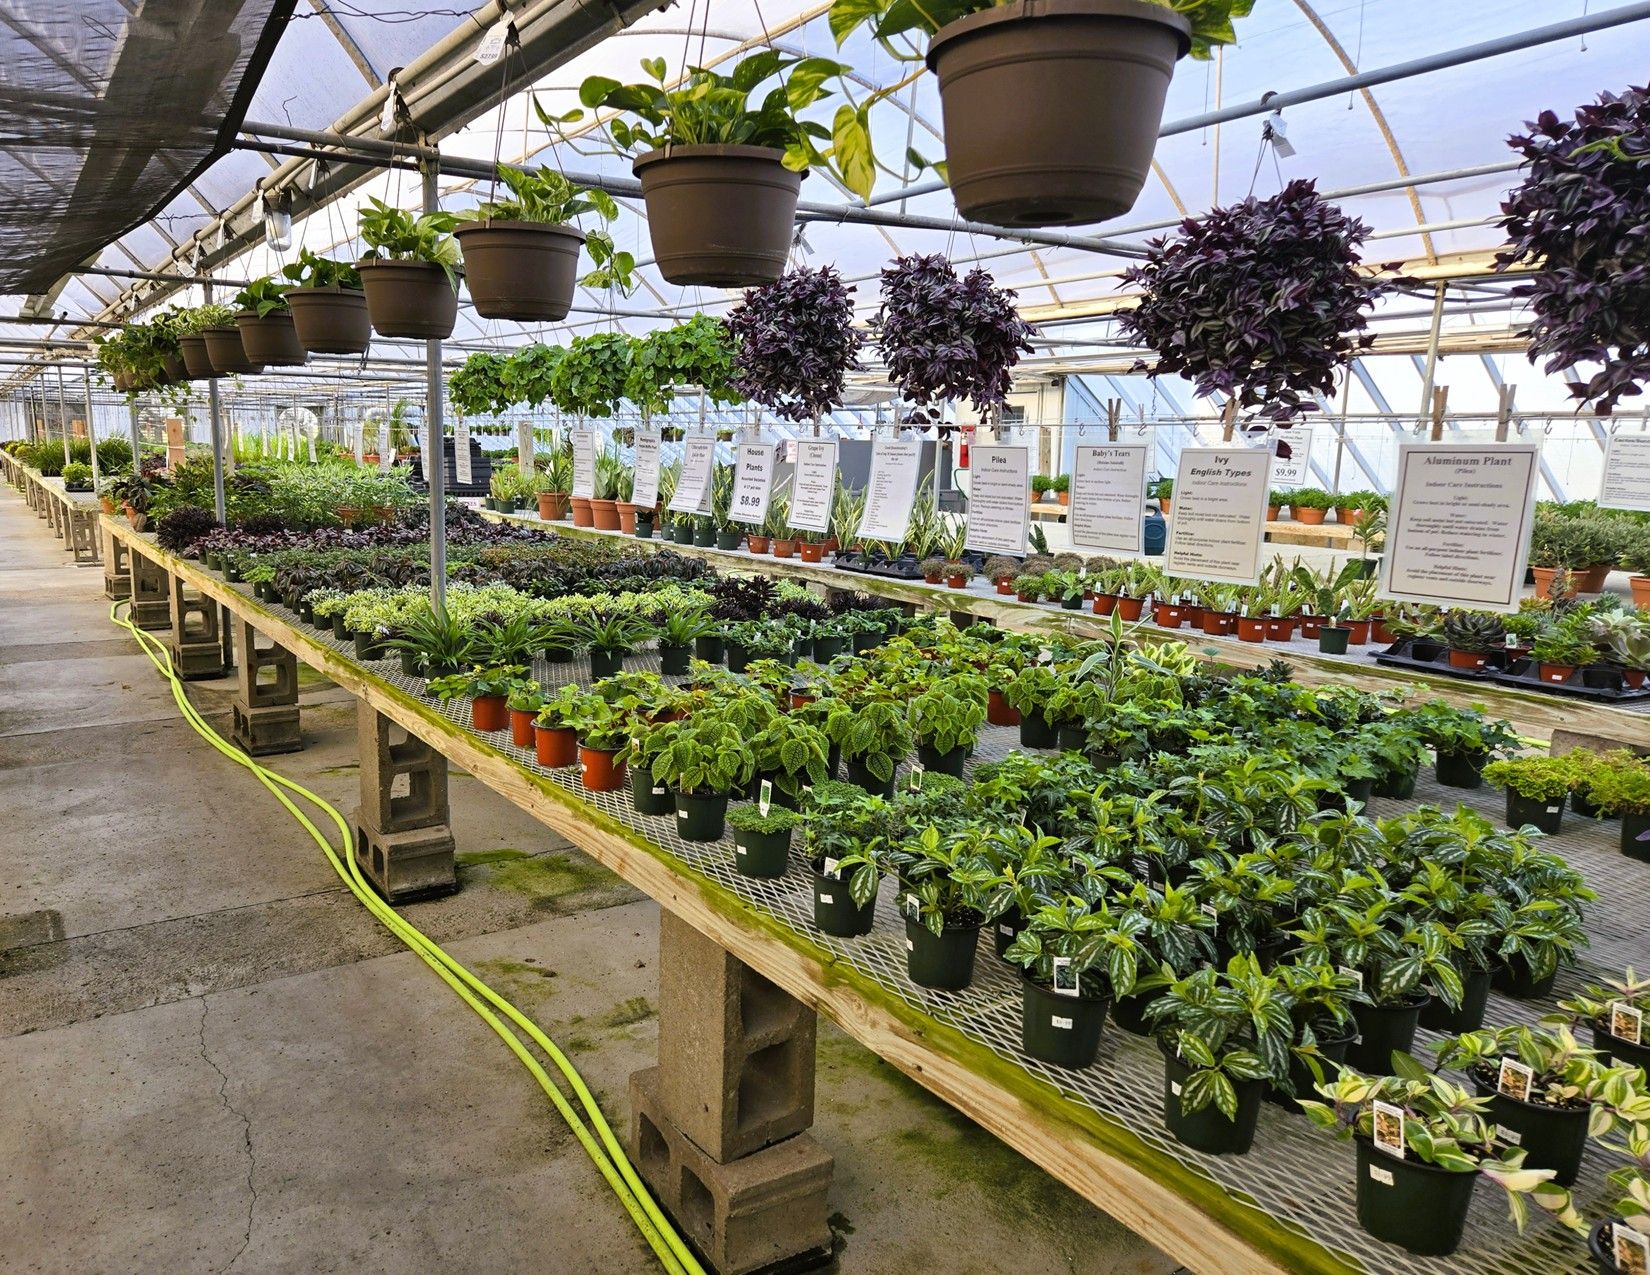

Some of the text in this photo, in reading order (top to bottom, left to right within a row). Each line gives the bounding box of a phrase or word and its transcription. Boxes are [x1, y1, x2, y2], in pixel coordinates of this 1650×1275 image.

[747, 447, 764, 457] House
[1092, 449, 1113, 459] Baby's
[991, 456, 1007, 464] Pilea
[1215, 456, 1229, 464] Ivy
[1424, 457, 1512, 465] Aluminum Plant
[746, 463, 763, 472] Plants
[1275, 467, 1297, 477] $9.99
[1190, 468, 1252, 479] English Types
[740, 495, 761, 507] $8.99
